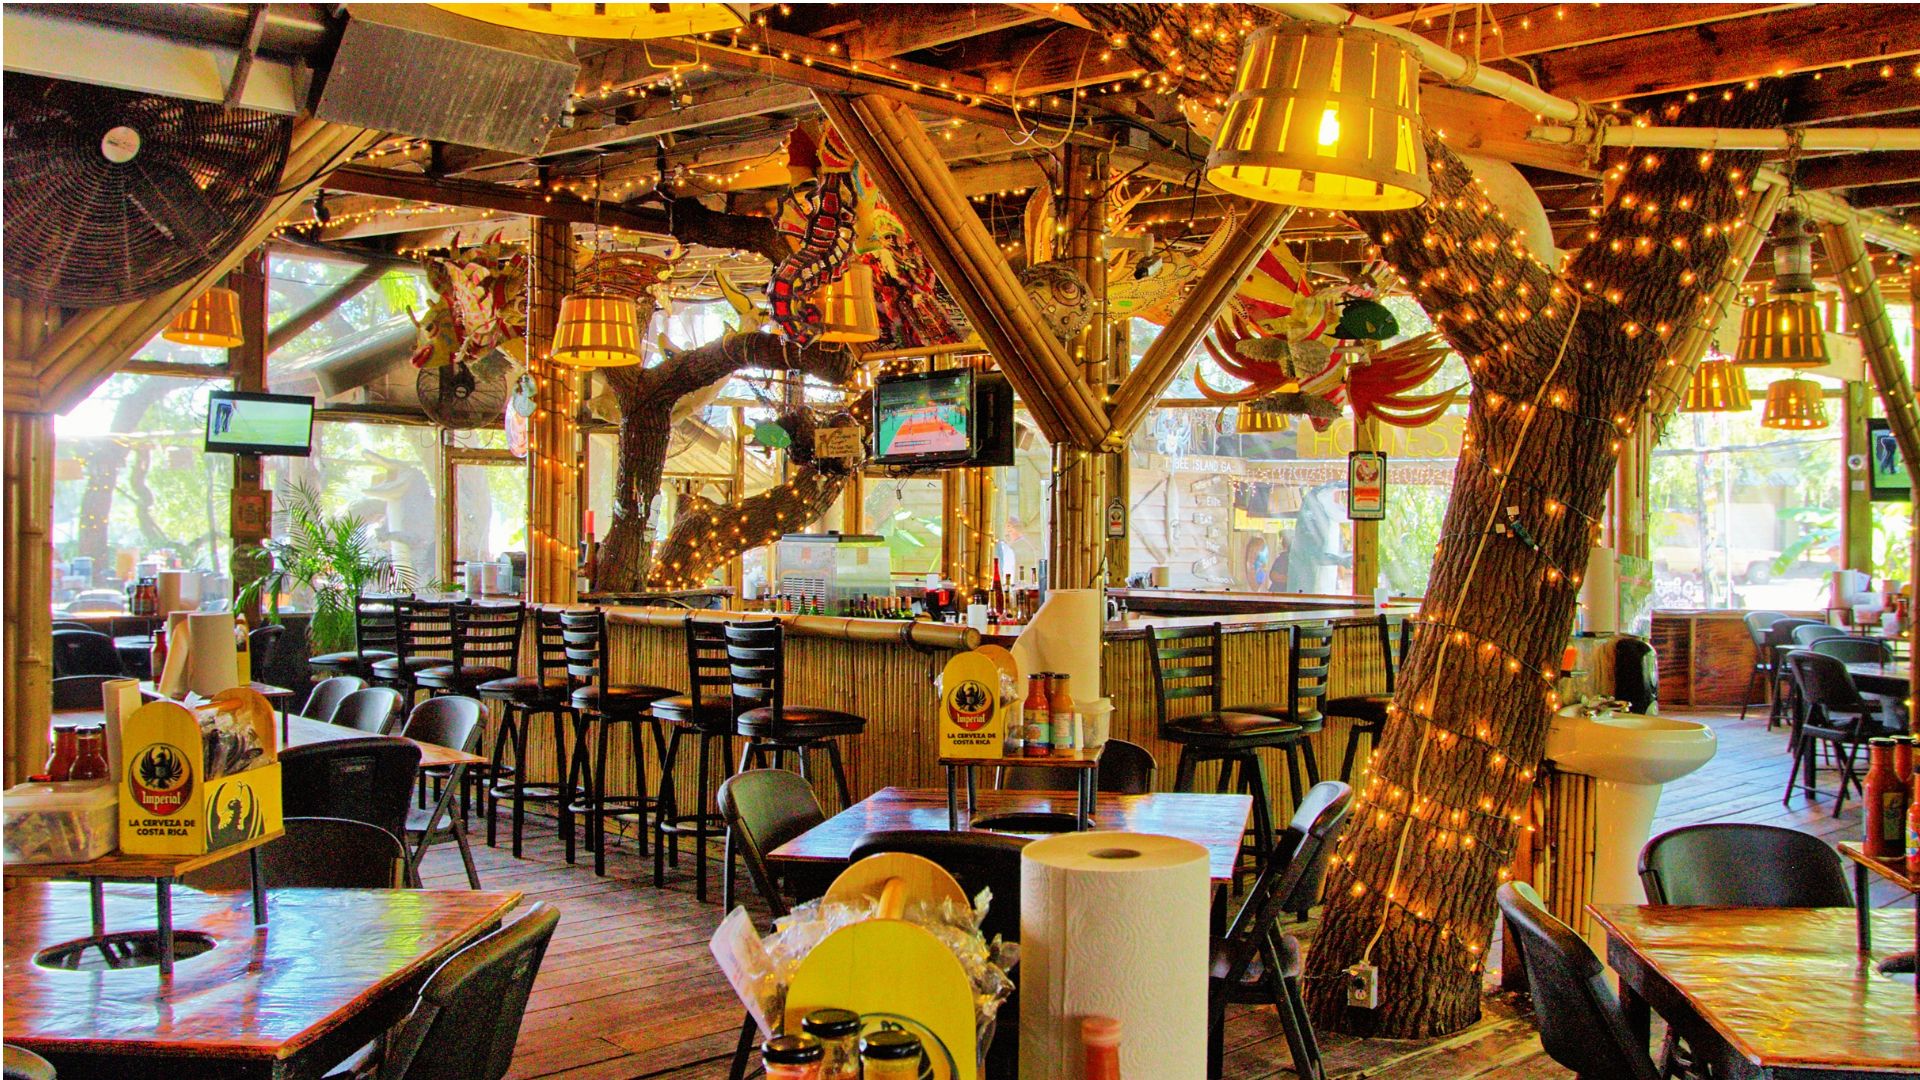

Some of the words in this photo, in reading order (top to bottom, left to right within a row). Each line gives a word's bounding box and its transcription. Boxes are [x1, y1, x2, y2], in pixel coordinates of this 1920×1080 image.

[1164, 457, 1190, 470] TBEE
[1192, 459, 1218, 472] ISLAND
[957, 712, 985, 728] Imperial
[142, 790, 181, 811] Imperial
[129, 819, 140, 827] LA
[142, 819, 182, 828] CERVEZA
[183, 819, 196, 828] DE
[136, 828, 166, 836] COSTA
[167, 828, 188, 836] RICA
